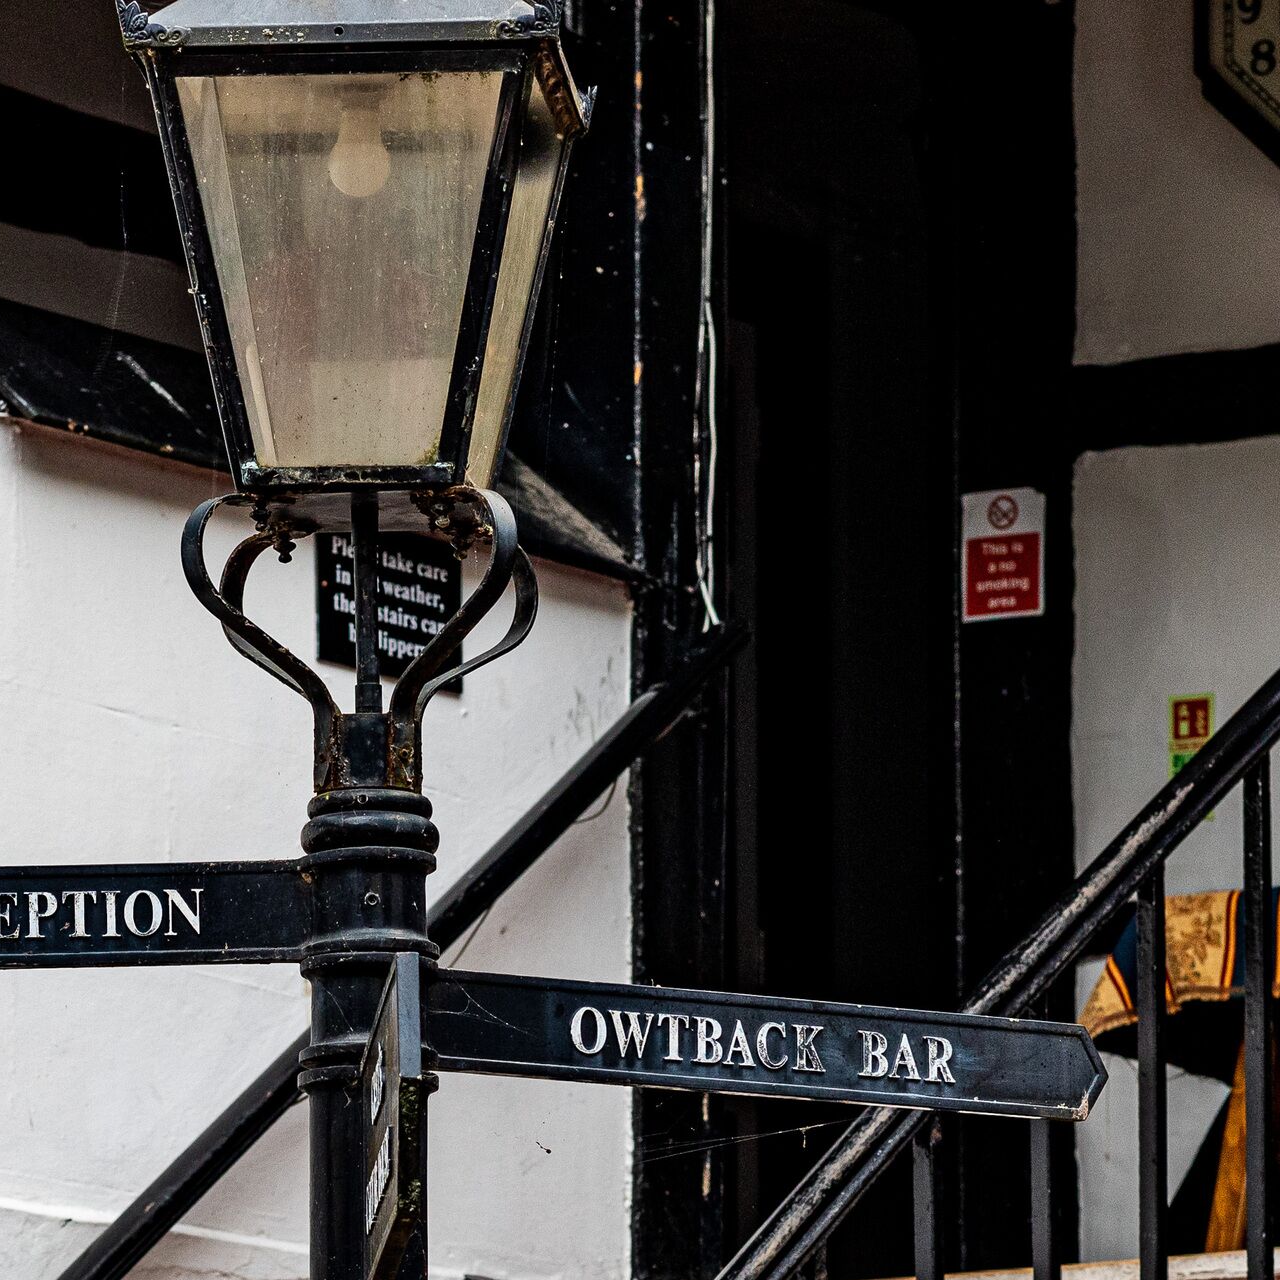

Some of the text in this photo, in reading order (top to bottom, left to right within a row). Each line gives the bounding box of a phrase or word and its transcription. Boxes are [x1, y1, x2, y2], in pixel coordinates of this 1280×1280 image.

[1250, 38, 1277, 76] 8
[382, 551, 414, 575] take
[417, 562, 449, 583] care
[335, 563, 352, 586] in
[383, 580, 446, 614] weather,
[976, 577, 1030, 593] smoking
[377, 605, 418, 631] stairs
[987, 596, 1017, 609] area
[570, 1005, 957, 1085] OWTBACK BAR
